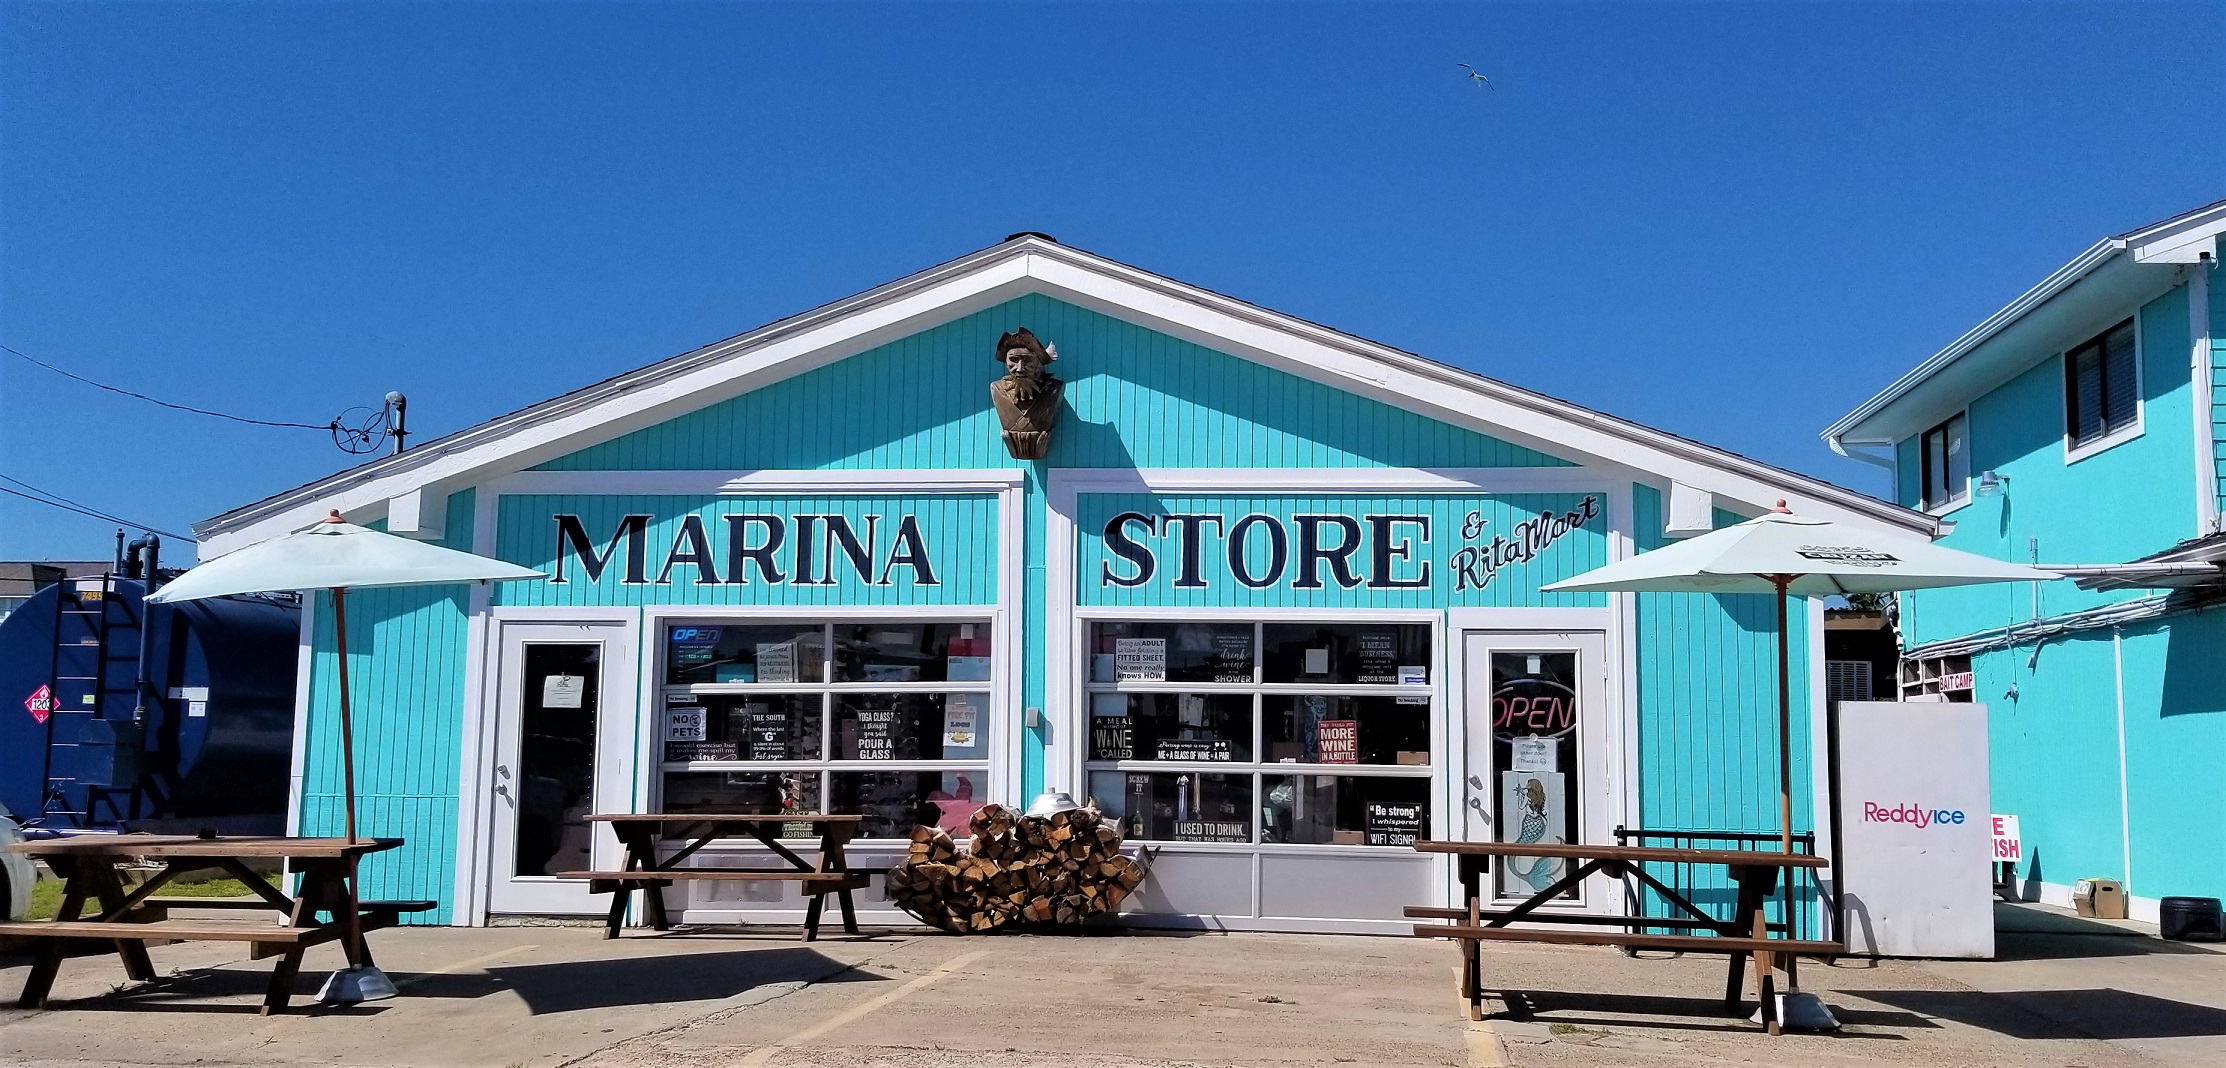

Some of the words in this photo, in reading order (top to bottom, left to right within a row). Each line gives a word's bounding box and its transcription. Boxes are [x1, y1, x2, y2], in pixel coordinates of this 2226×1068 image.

[1460, 509, 1490, 541] &
[547, 513, 943, 586] MARINA
[1101, 511, 1433, 589] STORE
[1220, 648, 1249, 660] drink
[1145, 664, 1164, 672] really
[1222, 661, 1248, 669] wine
[1117, 671, 1142, 679] knows
[1144, 671, 1164, 679] HOW.
[1214, 675, 1252, 683] SHOWER
[1358, 675, 1379, 683] LIQUOR
[1939, 676, 1954, 690] BAIT
[1955, 673, 1973, 689] CAMP
[858, 712, 873, 722] YOGA
[873, 712, 894, 722] CLASS?
[1492, 697, 1575, 728] OPEN
[672, 715, 689, 724] NO
[1107, 717, 1133, 725] MEAL
[672, 727, 701, 736] PETS
[1320, 728, 1355, 739] MORE
[1096, 729, 1133, 748] WINE
[858, 739, 884, 748] POUR
[886, 739, 892, 748] A
[1320, 740, 1355, 751] WINE
[689, 753, 718, 761] wine
[860, 750, 890, 759] GLASS
[1100, 748, 1133, 759] CALLED
[1157, 750, 1166, 760] ME
[1169, 750, 1174, 760] A
[1174, 750, 1190, 760] GLASS
[1190, 750, 1197, 760] OF
[1197, 751, 1210, 760] WINE
[1218, 751, 1230, 761] PAIR
[1321, 752, 1328, 760] IN
[1334, 752, 1356, 761] BOTTLE
[1128, 774, 1150, 783] SCREW
[1135, 783, 1143, 792] IT
[1377, 818, 1419, 826] whispered
[1175, 822, 1179, 835] I
[1180, 822, 1203, 835] USED
[1203, 823, 1215, 835] TO
[783, 831, 794, 839] GO
[1370, 833, 1388, 845] WIFI
[1991, 838, 2020, 859] ISH
